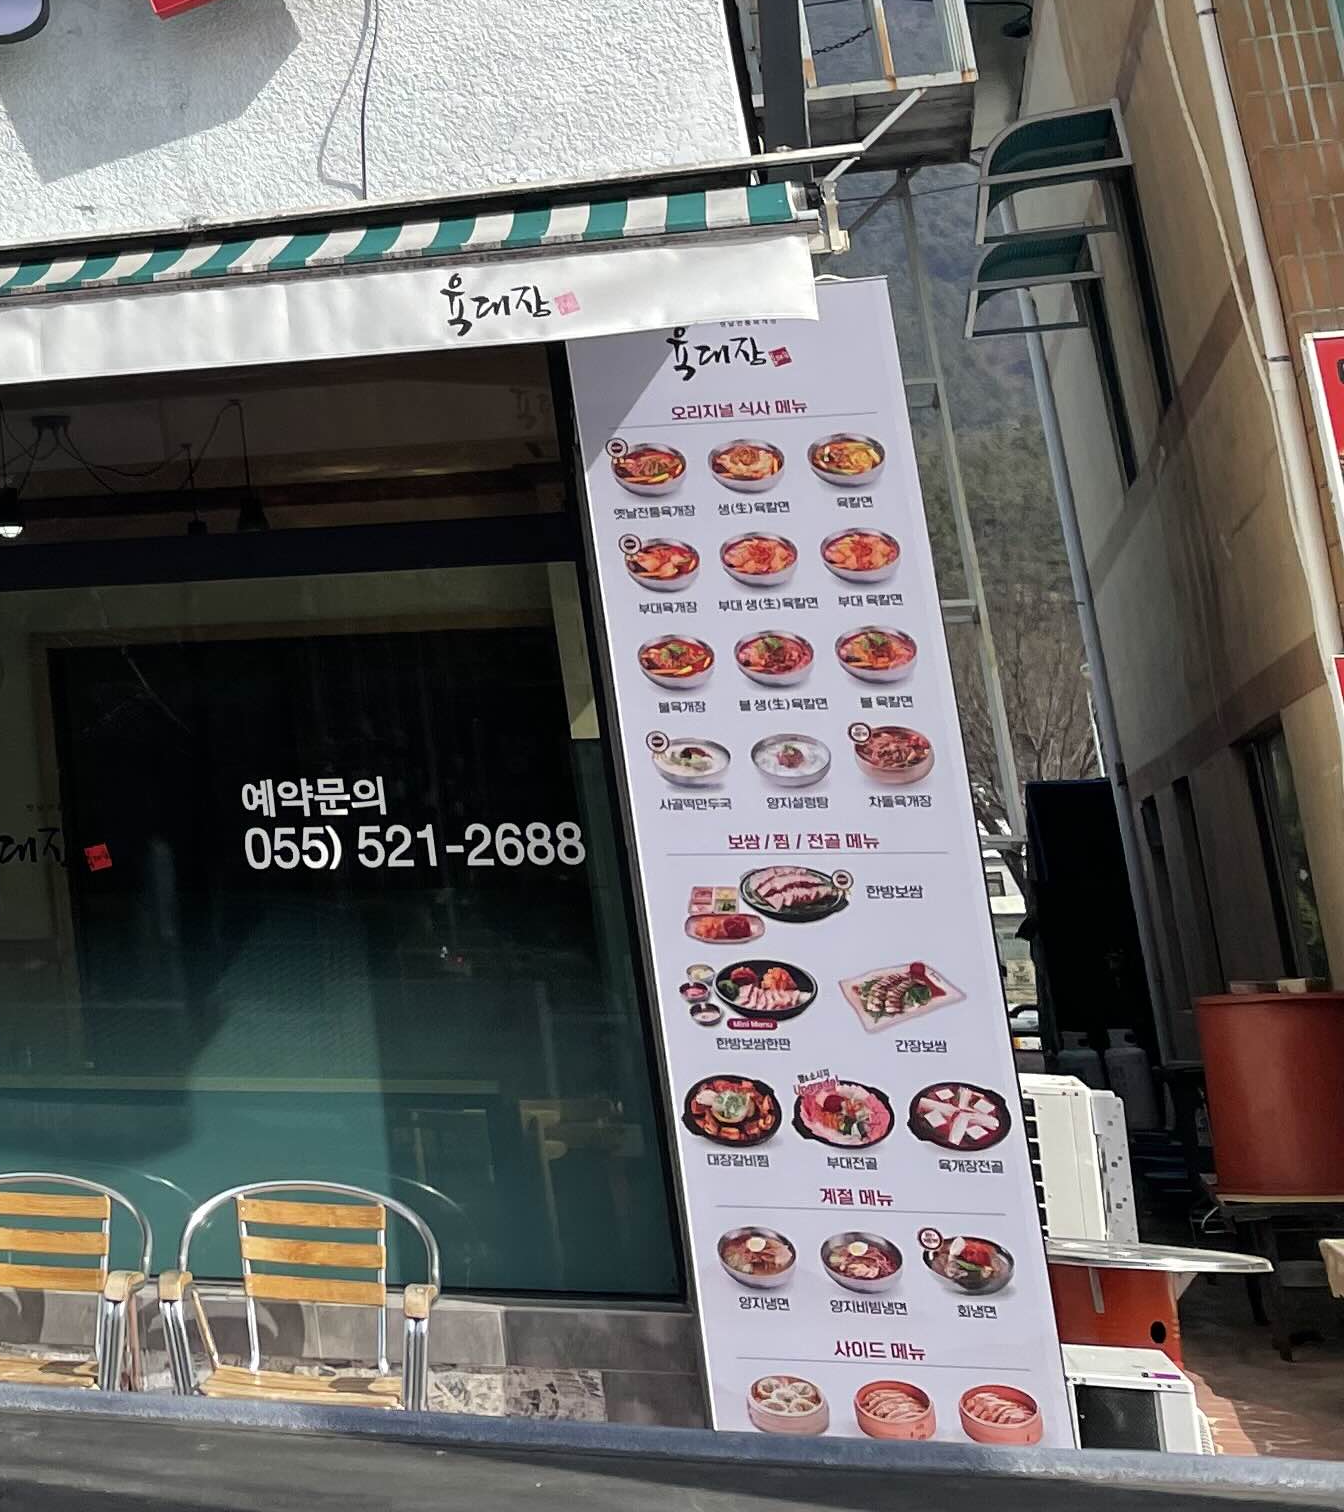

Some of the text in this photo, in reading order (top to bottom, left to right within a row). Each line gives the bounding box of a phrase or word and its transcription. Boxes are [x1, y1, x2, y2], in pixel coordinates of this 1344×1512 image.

[440, 273, 552, 336] 육대장
[666, 326, 768, 382] 육대장
[670, 398, 808, 421] 오리지널 식사 메뉴
[718, 599, 743, 612] 부대
[837, 595, 863, 608] 부대
[241, 775, 387, 818] 예약문의
[244, 821, 586, 870] 055) 521-2688
[728, 833, 760, 850] 보쌈
[773, 833, 790, 850] 찜
[808, 833, 841, 849] 전골
[846, 833, 880, 849] 메뉴
[865, 884, 923, 899] 한방보쌈
[895, 1039, 948, 1053] 간장보쌈
[707, 1153, 769, 1168] 대장갈비찜
[826, 1156, 878, 1171] 부대전골
[938, 1159, 1004, 1174] 육개장전골
[820, 1187, 894, 1207] 계절 메뉴
[738, 1295, 791, 1312] 양지냉면
[830, 1299, 909, 1316] 양지비빔냉면
[957, 1304, 998, 1319] 회냉면
[834, 1340, 926, 1361] 사이드 메뉴
